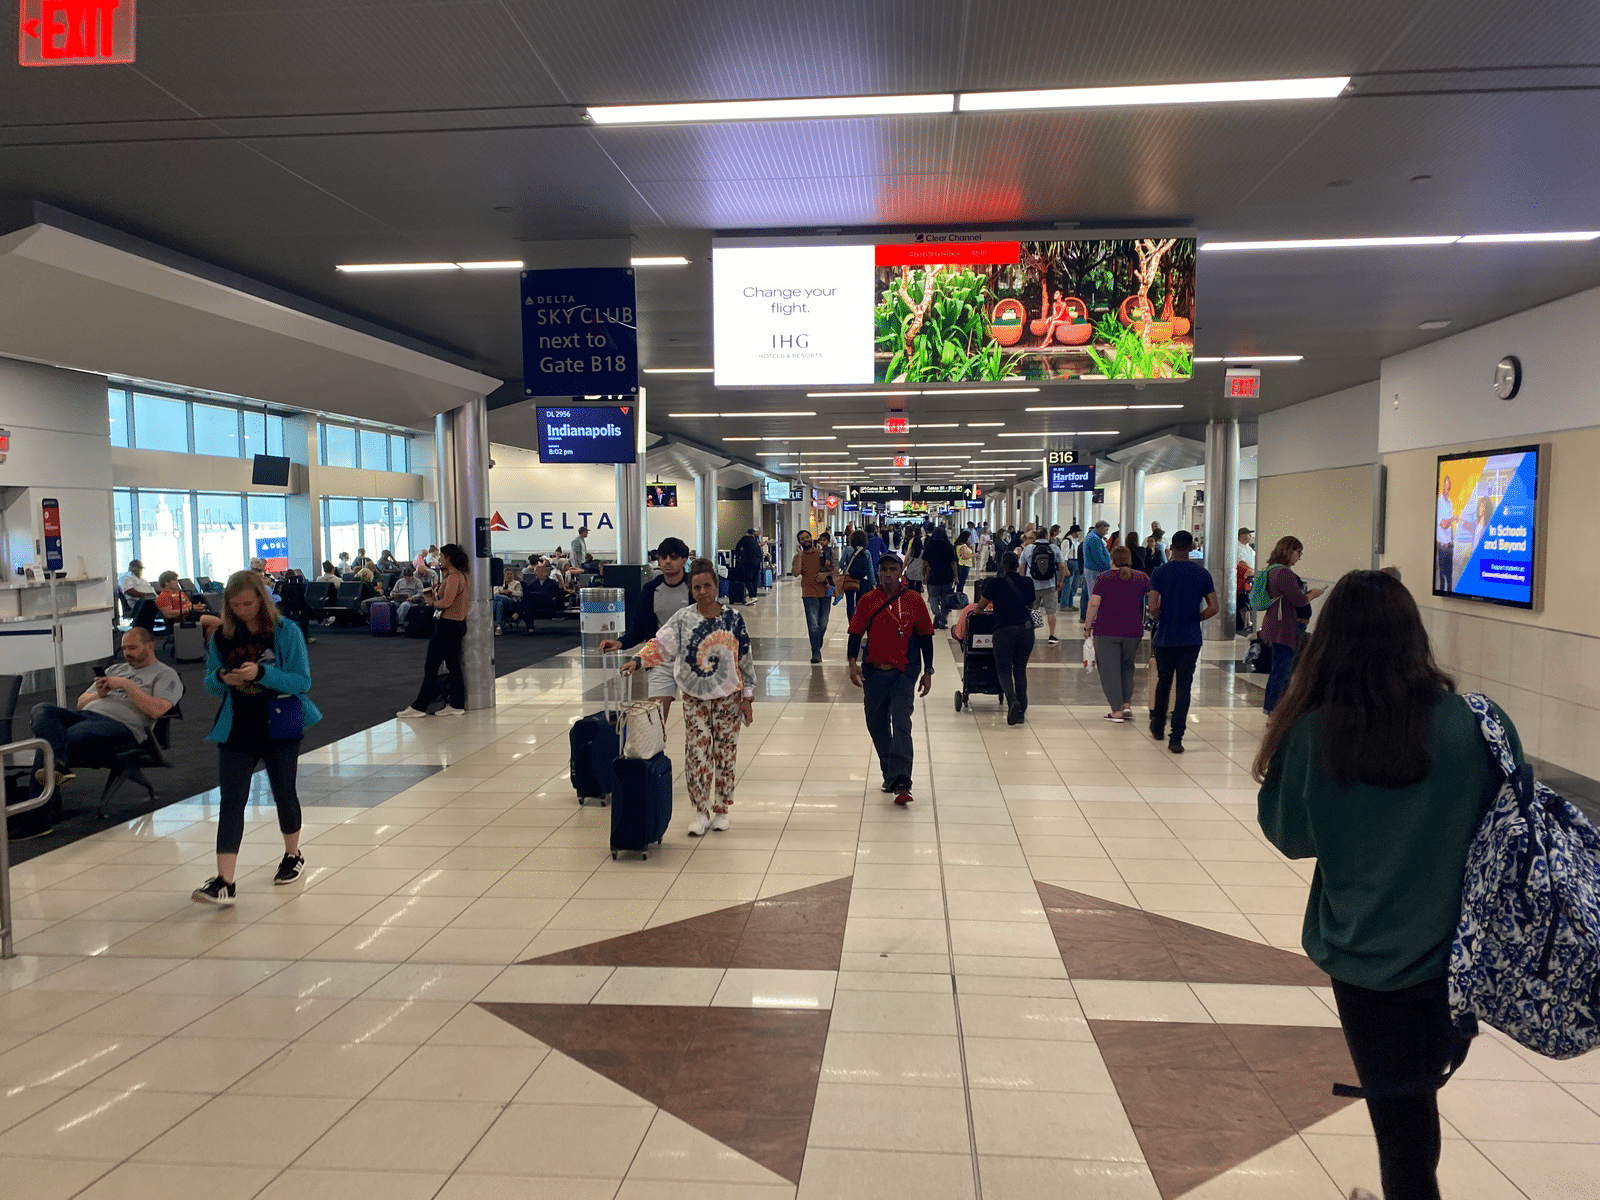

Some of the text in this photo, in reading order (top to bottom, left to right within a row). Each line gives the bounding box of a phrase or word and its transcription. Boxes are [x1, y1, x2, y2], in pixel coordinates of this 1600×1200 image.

[41, 0, 119, 59] EXIT
[926, 233, 982, 242] Clear Channel
[537, 295, 576, 304] DELTA
[743, 287, 838, 300] Change your
[537, 306, 633, 325] SKY CLUB
[771, 302, 810, 316] flight.
[539, 332, 607, 349] next to
[772, 333, 809, 349] IHG
[540, 355, 627, 373] Gate B18
[1231, 377, 1255, 397] EXIT
[546, 410, 556, 418] DL
[547, 423, 622, 440] Indianapolis
[1049, 451, 1074, 464] B16
[1053, 471, 1089, 481] Hartford
[517, 512, 614, 530] DELTA
[1489, 524, 1527, 537] In Schools
[1484, 538, 1527, 553] and Beyond
